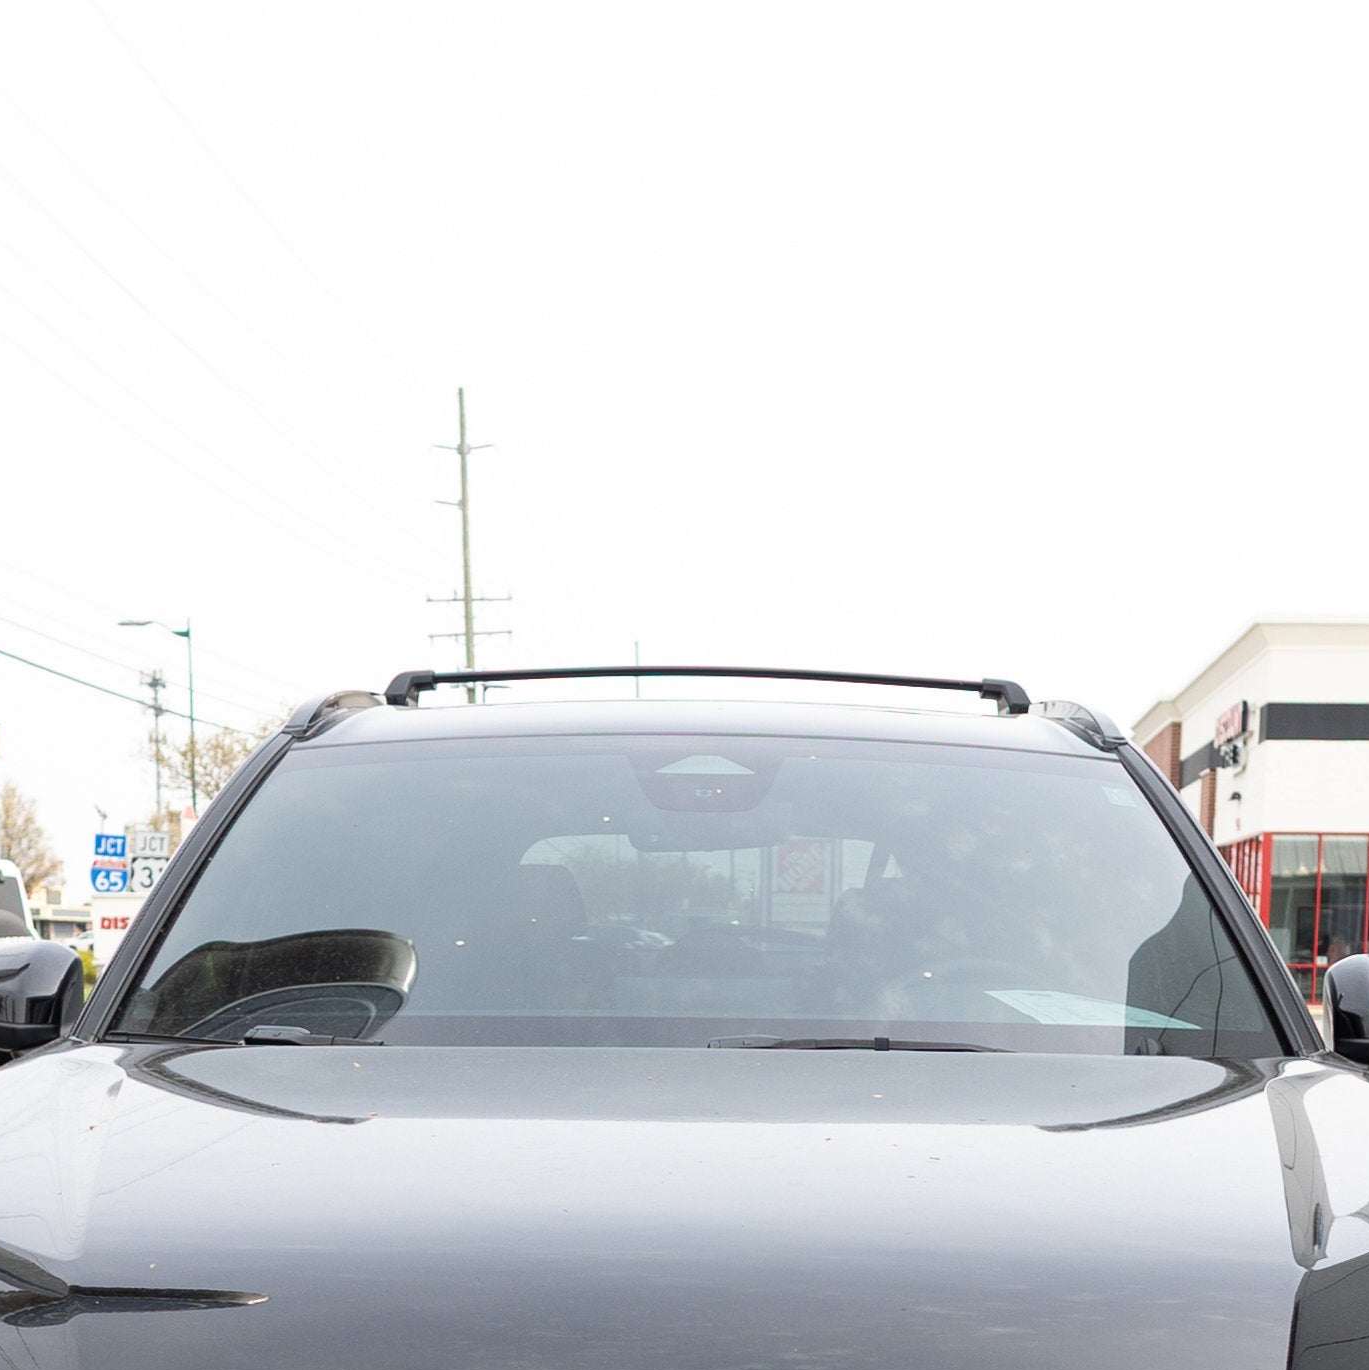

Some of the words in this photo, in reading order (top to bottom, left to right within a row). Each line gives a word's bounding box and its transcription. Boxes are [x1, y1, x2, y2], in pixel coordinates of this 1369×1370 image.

[97, 838, 123, 854] JCT
[140, 837, 165, 851] JCT
[95, 871, 123, 891] 65
